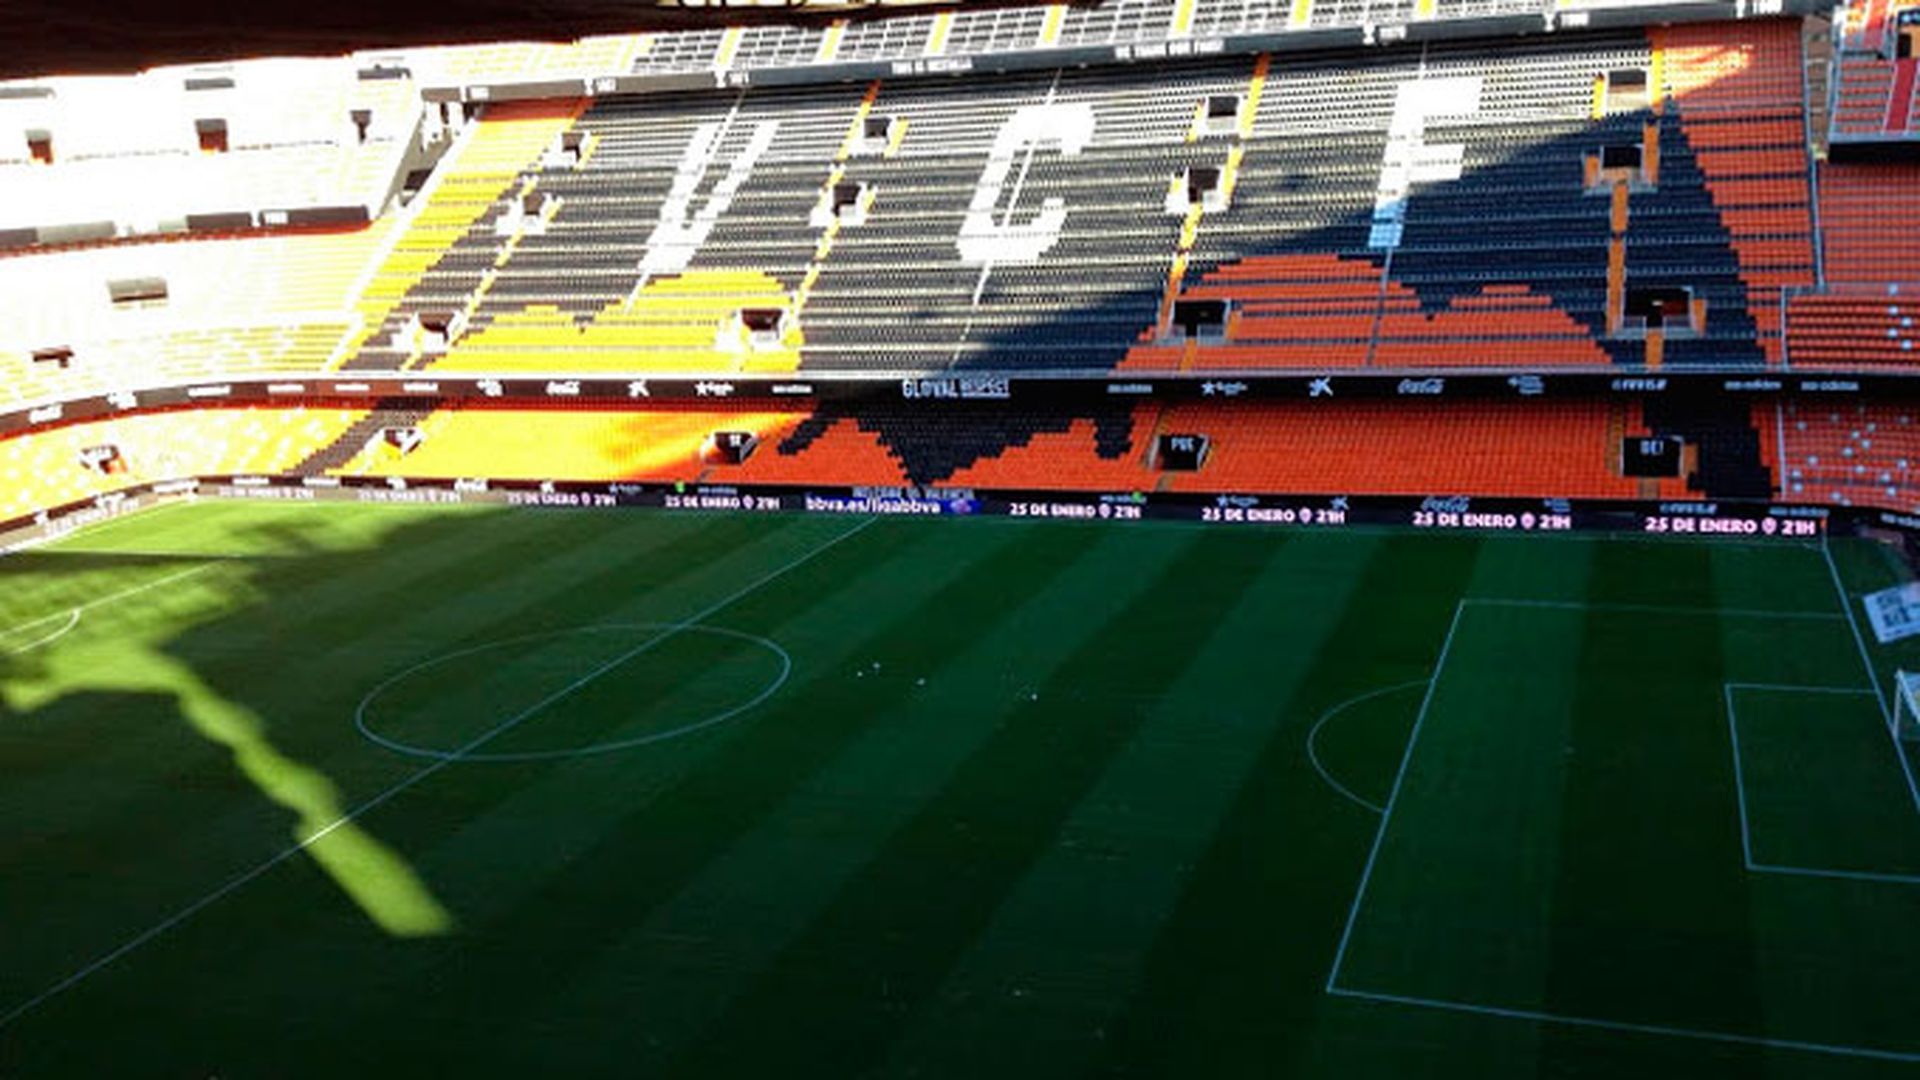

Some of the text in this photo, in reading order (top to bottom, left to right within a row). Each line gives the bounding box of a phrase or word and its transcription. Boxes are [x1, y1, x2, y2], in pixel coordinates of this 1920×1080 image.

[955, 103, 1096, 262] C
[1368, 77, 1483, 248] F
[1010, 502, 1028, 515] 25
[1030, 503, 1049, 516] DE
[1051, 504, 1097, 518] ENERO
[1202, 507, 1345, 523] 25 DE ENERO 21H
[1413, 511, 1571, 530] 25 DE ENERO 21H
[1645, 517, 1816, 535] 25 DE ENERO 21H
